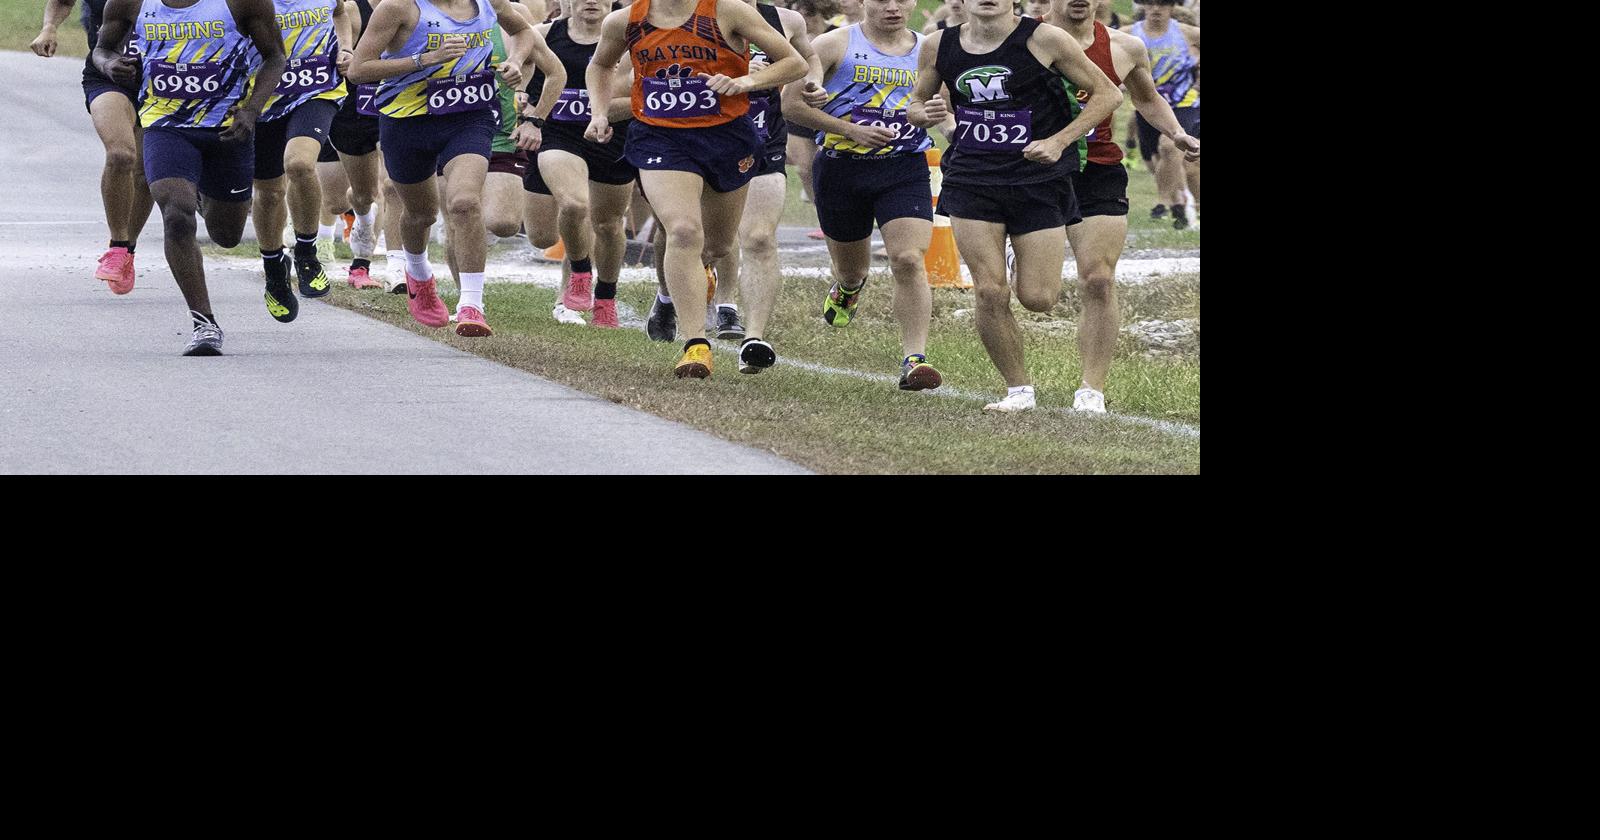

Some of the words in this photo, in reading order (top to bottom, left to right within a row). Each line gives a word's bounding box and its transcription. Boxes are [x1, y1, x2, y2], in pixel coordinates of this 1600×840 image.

[275, 6, 331, 30] RUINS
[144, 20, 225, 41] BRUINS
[427, 29, 493, 50] BINS
[153, 74, 219, 93] 6986
[276, 66, 329, 89] 985
[853, 65, 918, 87] BRUIN
[429, 83, 494, 109] 6980
[646, 90, 717, 111] 6993
[556, 99, 592, 115] 705
[856, 119, 916, 140] 82
[958, 120, 1028, 144] 7032
